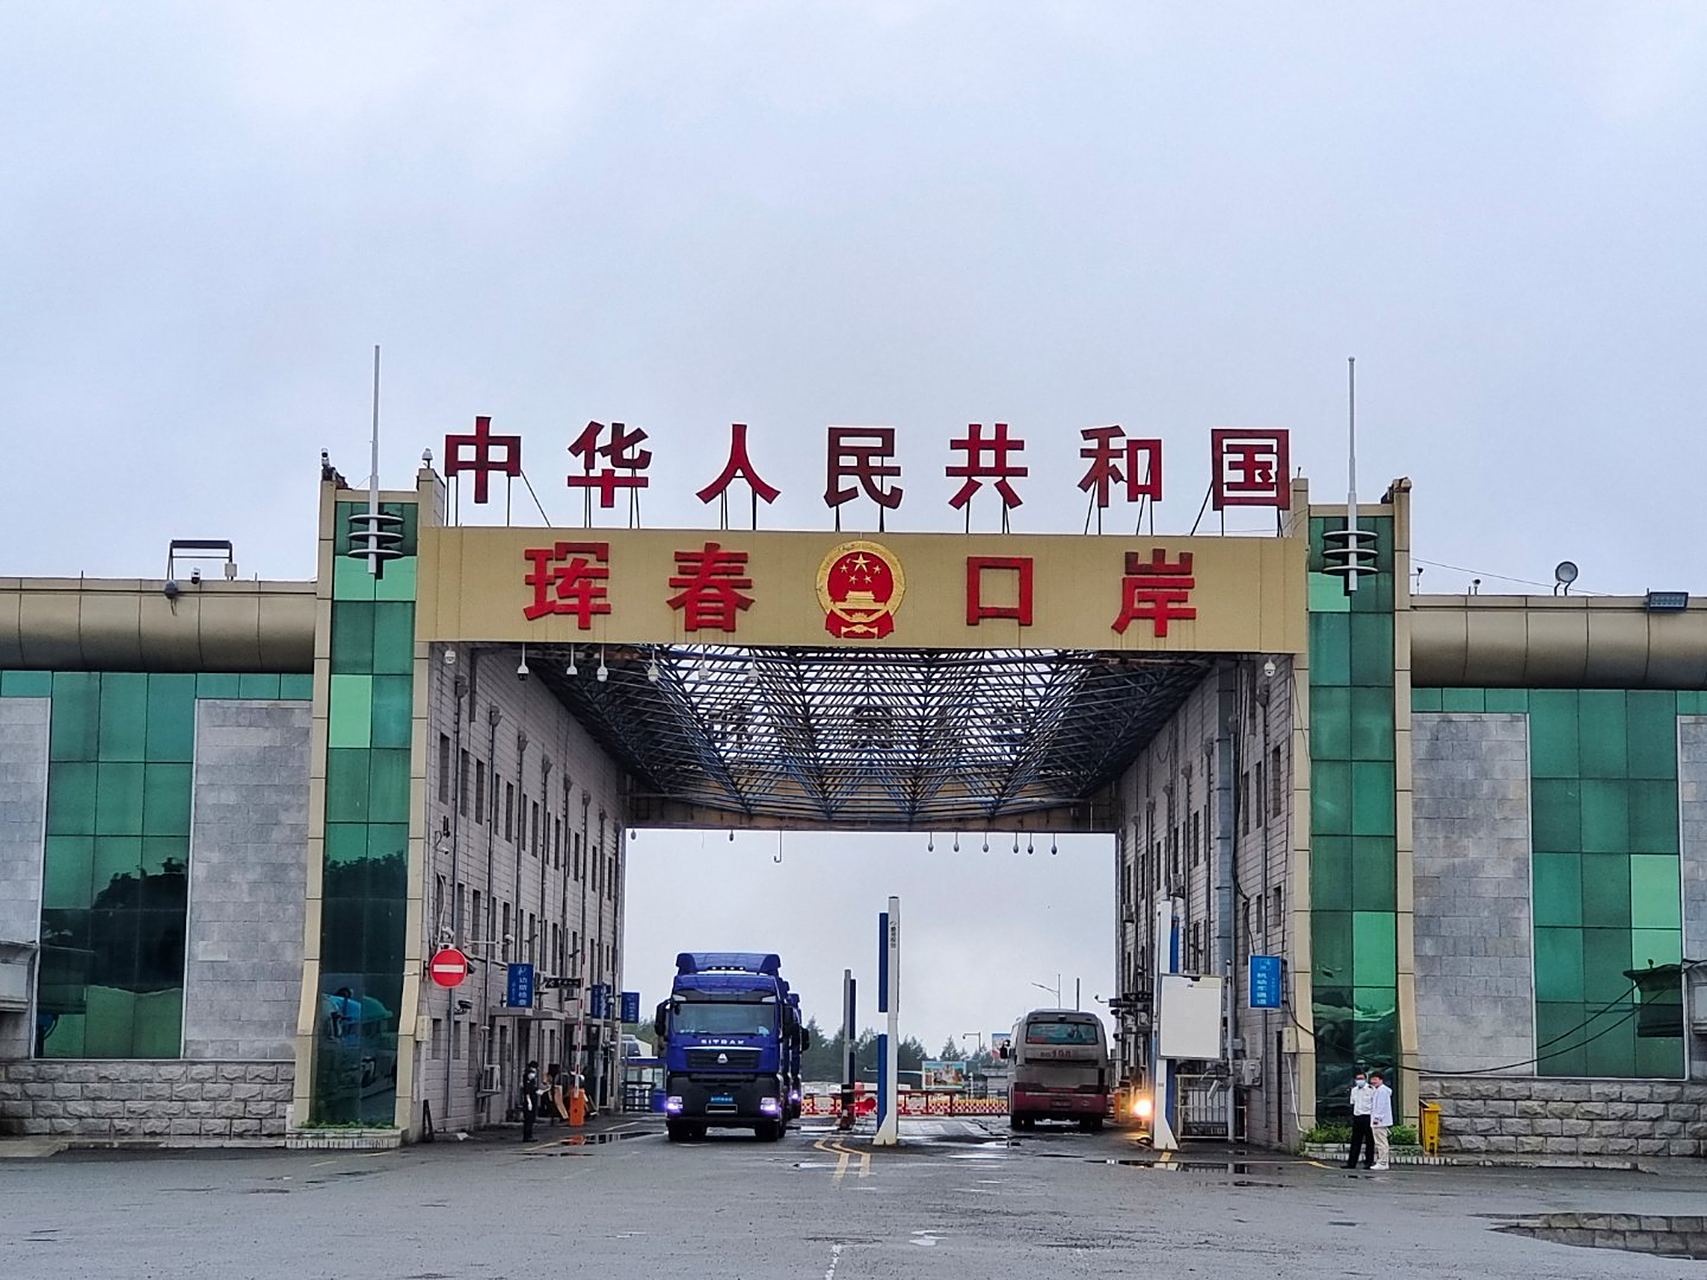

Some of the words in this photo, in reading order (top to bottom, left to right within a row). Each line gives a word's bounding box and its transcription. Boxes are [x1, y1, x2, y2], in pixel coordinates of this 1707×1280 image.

[445, 416, 1290, 511] 中华人民共和国
[522, 541, 1198, 639] 珲春口岸
